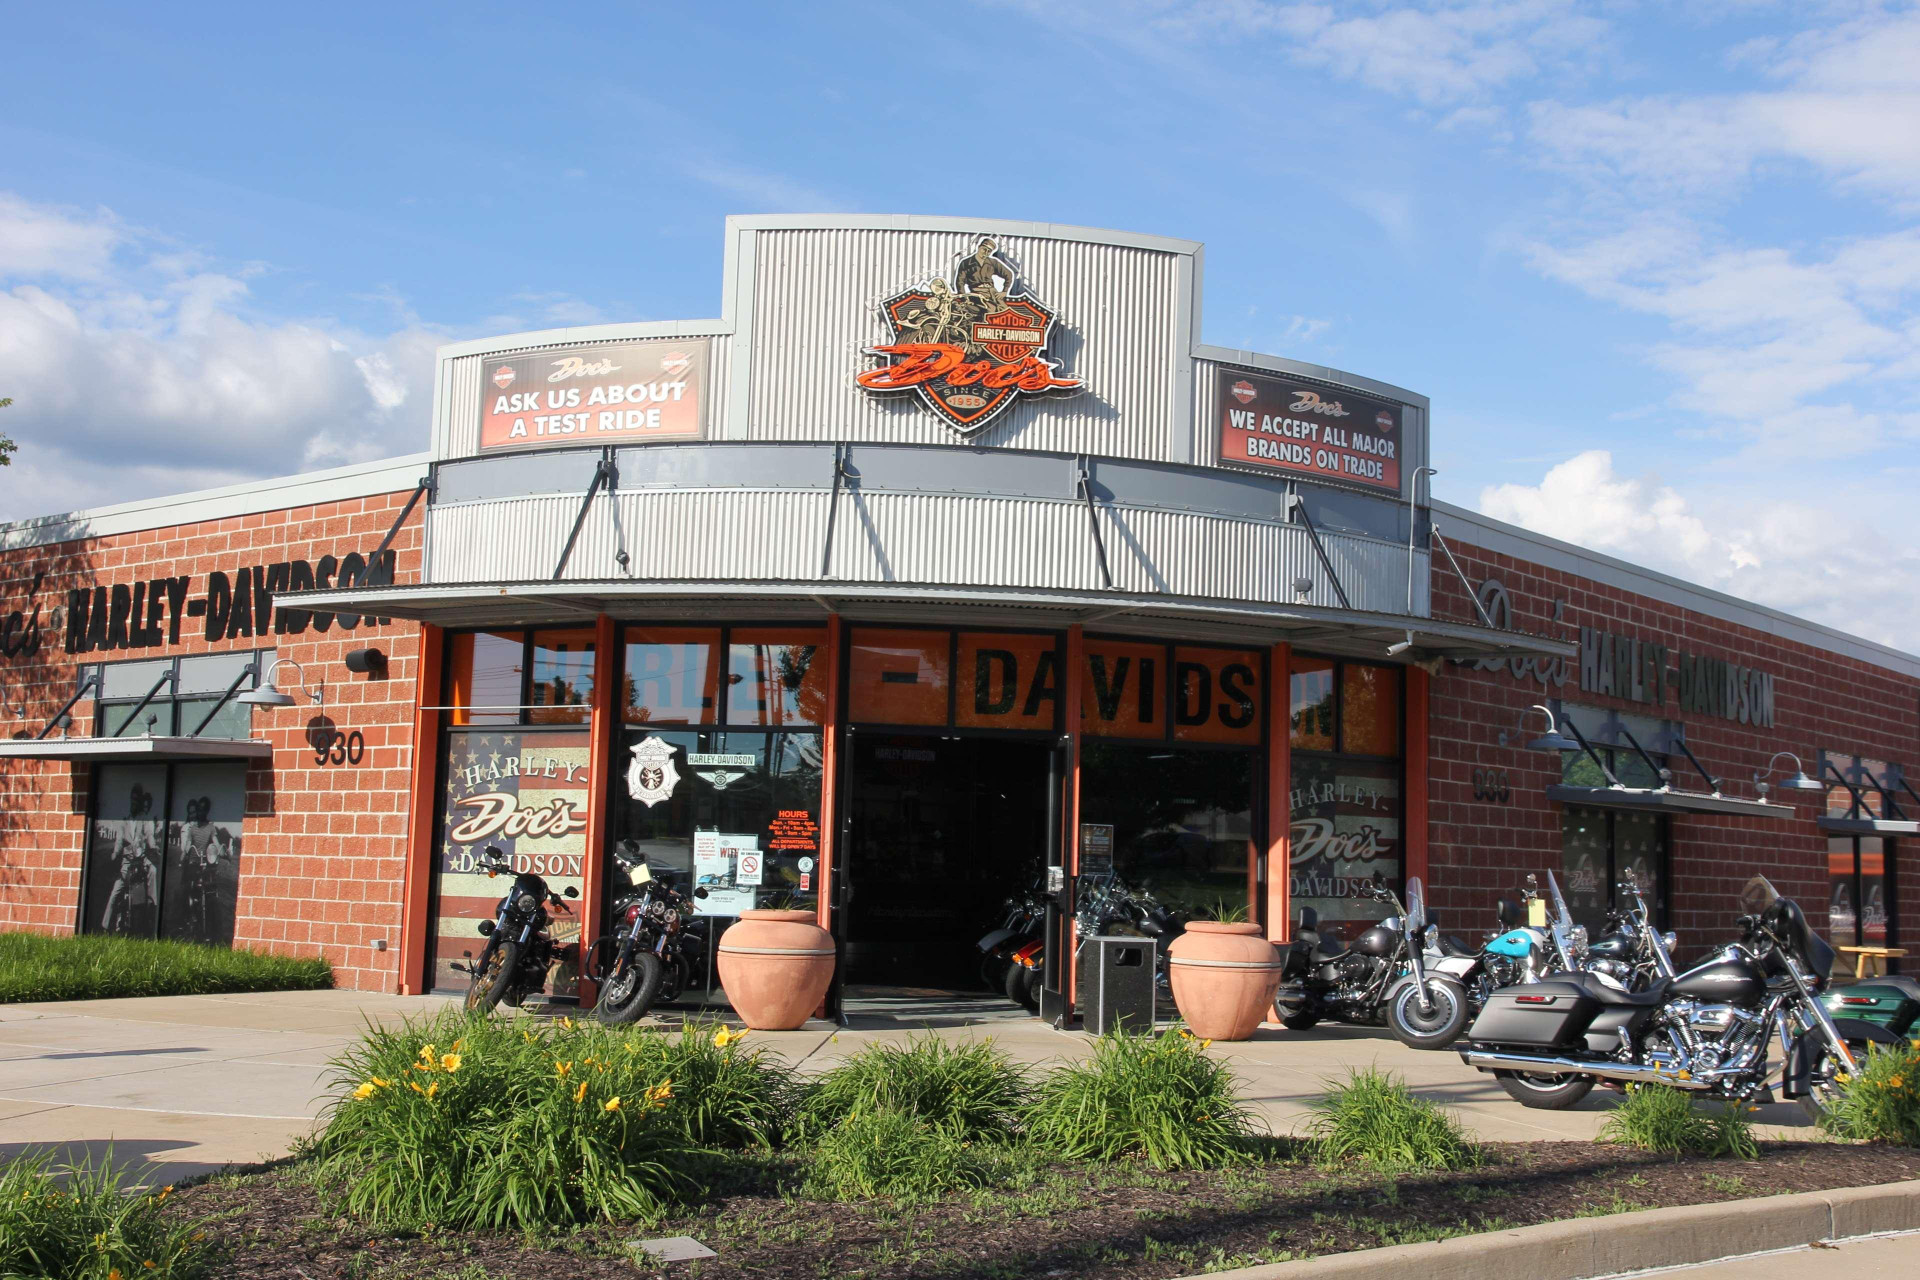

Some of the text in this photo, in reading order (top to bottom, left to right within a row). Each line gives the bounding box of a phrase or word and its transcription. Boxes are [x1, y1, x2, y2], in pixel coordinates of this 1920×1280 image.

[977, 327, 1040, 343] HARLEY-DAVIDSON
[992, 314, 1026, 327] MOTOR
[991, 343, 1025, 359] CYCLES
[547, 356, 622, 383] Doc's
[856, 343, 1086, 390] Doc's
[493, 381, 686, 415] ASK US ABOUT
[943, 387, 990, 398] SINCE
[952, 397, 981, 407] 1955
[1289, 391, 1350, 417] Doc's
[509, 408, 661, 438] A TEST RIDE
[1229, 409, 1395, 459] WE ACCEPT ALL MAJOR
[1247, 437, 1383, 480] BRANDS ON TRADE
[1581, 625, 1775, 729] HARLEY-DAVIDSON
[315, 731, 364, 765] 930
[689, 755, 753, 765] HARLEY-DAVIDSON
[464, 756, 588, 788] HARLEY-
[1288, 782, 1389, 811] HARLEY-
[451, 792, 587, 842] Doc's
[1290, 818, 1392, 866] Doc's
